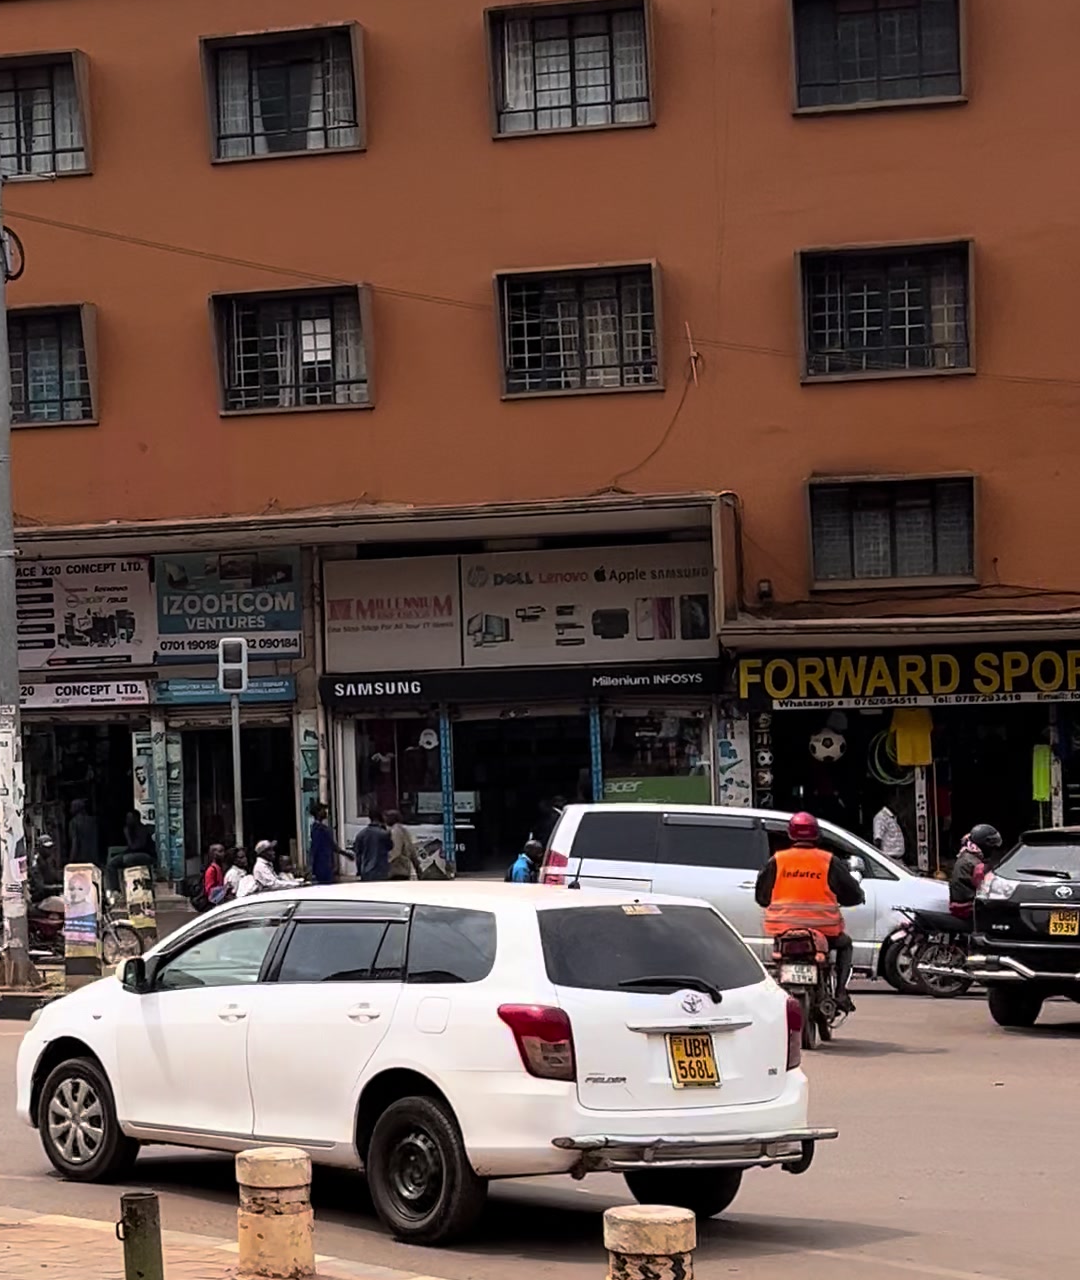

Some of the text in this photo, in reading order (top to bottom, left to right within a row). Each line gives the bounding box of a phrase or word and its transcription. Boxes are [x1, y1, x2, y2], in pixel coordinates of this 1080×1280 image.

[15, 562, 144, 577] ACE X20 CONCEPT LTD.
[609, 567, 646, 583] Apple
[162, 592, 295, 615] IZOOHCOM
[185, 615, 266, 631] VENTURES
[160, 640, 185, 651] 0701
[259, 638, 298, 649] 090184
[592, 673, 703, 686] Millenium INFOSYS
[739, 654, 960, 699] FORWARD
[20, 686, 35, 696] 20
[55, 685, 111, 696] CONCEPT
[116, 684, 142, 695] LTD.
[334, 681, 421, 696] SAMSUNG
[604, 780, 643, 793] acer
[684, 1038, 711, 1058] UBM
[678, 1061, 714, 1079] 568L
